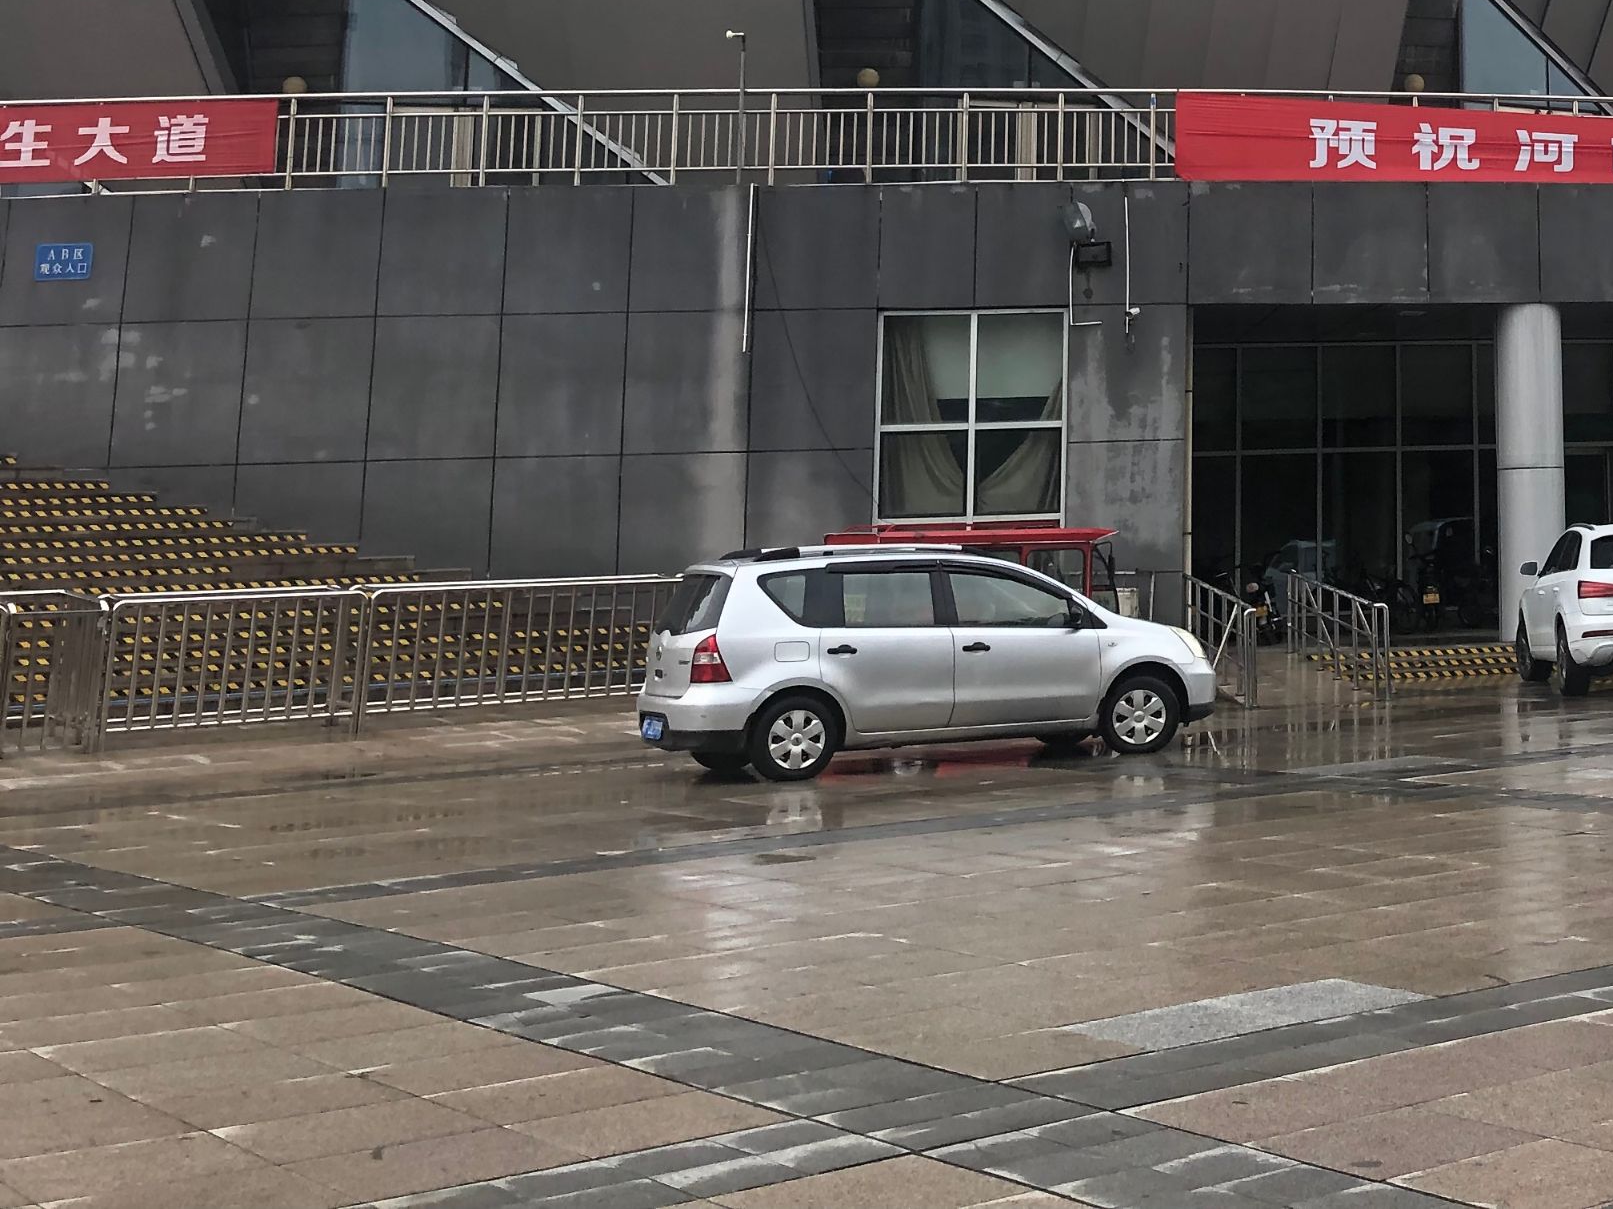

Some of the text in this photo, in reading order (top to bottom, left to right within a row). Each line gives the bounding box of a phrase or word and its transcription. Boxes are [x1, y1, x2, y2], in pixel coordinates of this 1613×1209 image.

[0, 114, 209, 167] 生大道
[40, 262, 87, 274] 观众入口
